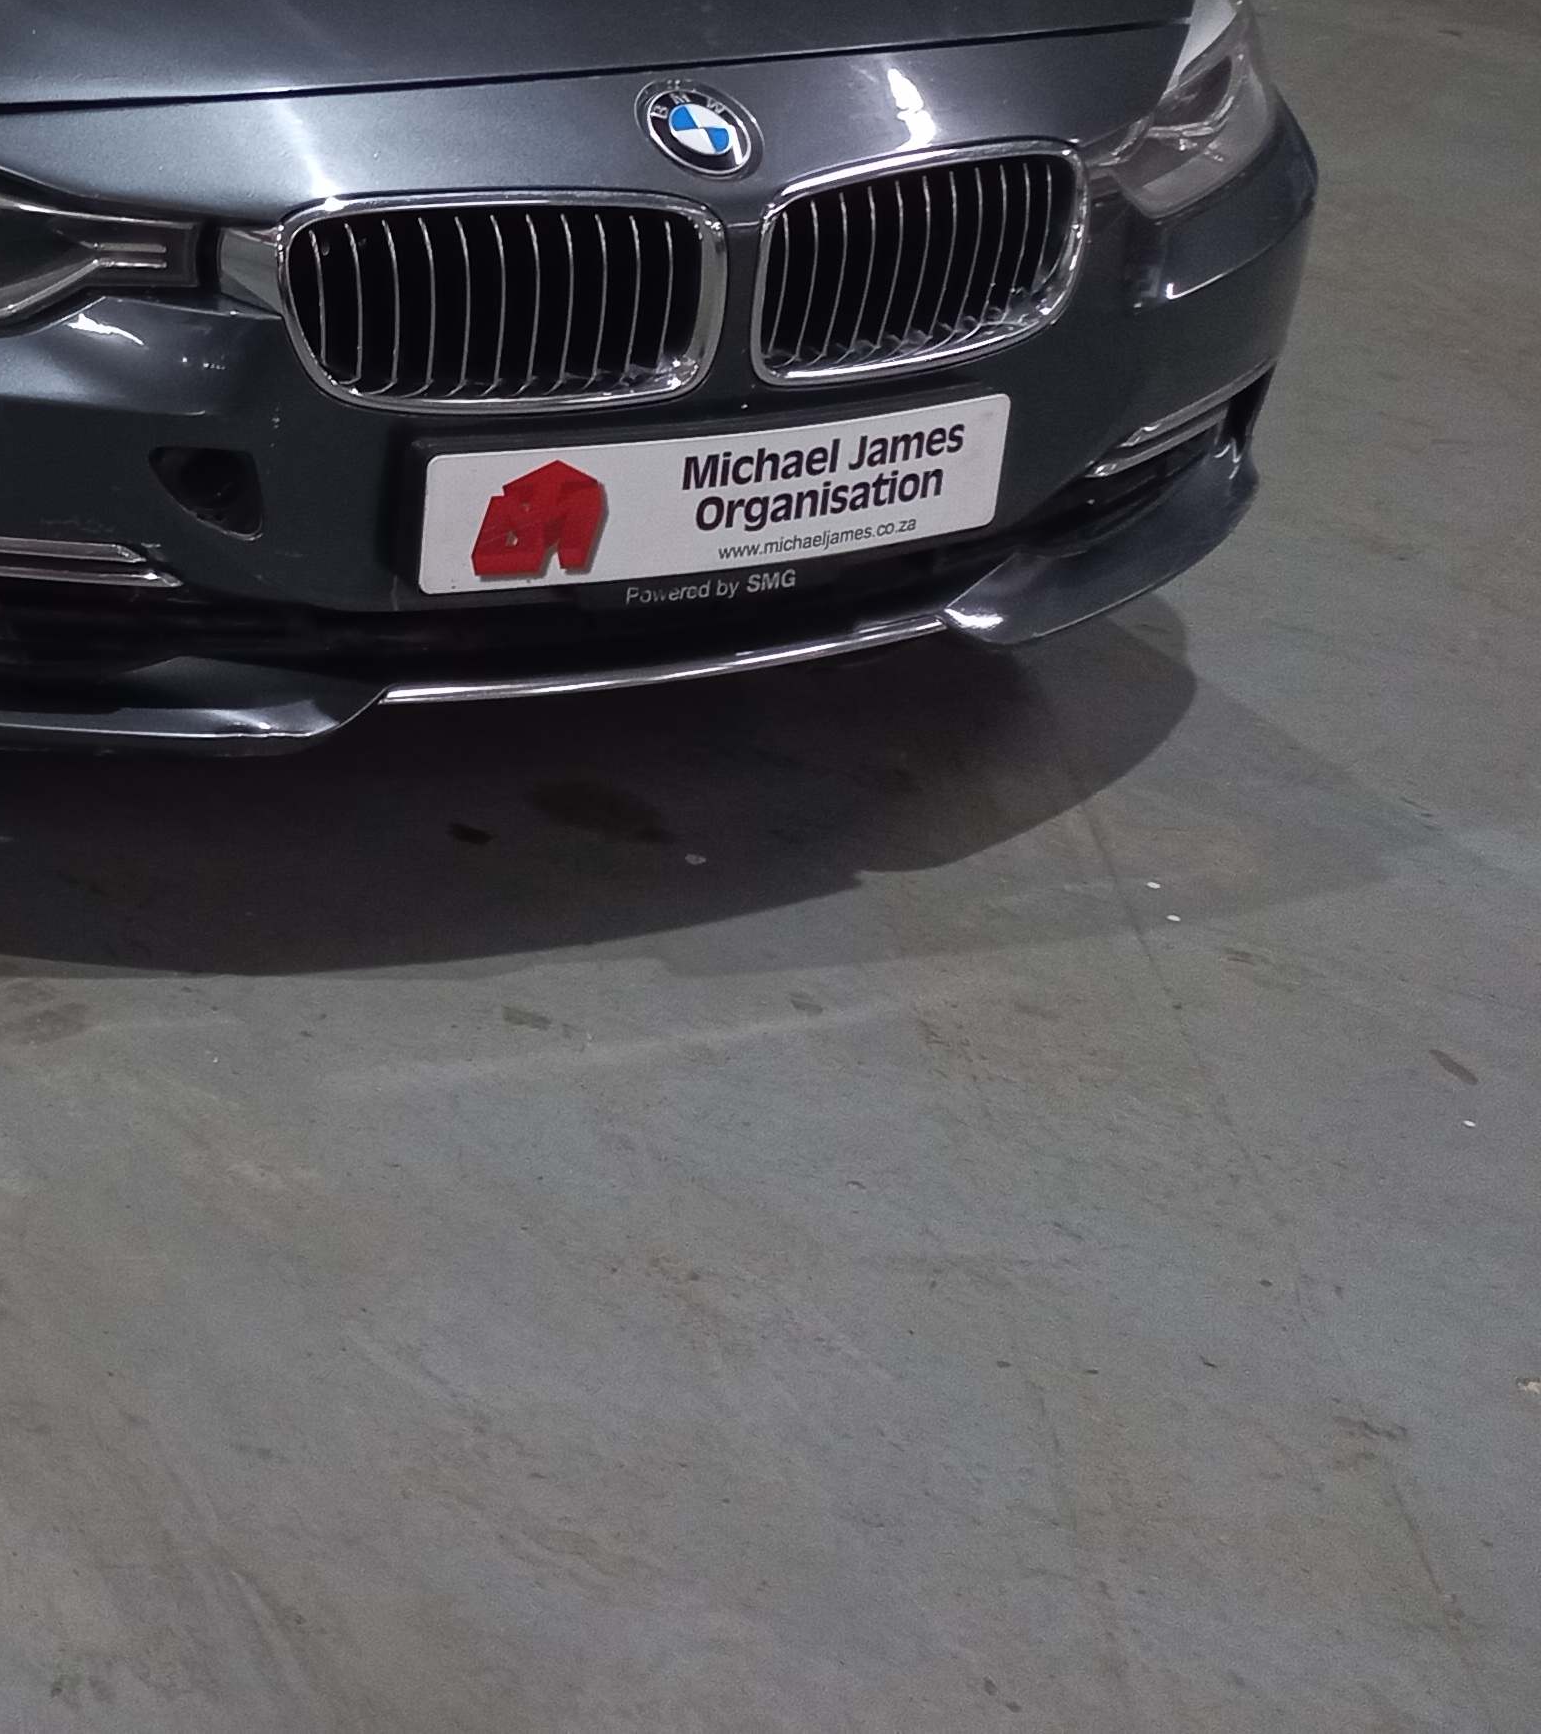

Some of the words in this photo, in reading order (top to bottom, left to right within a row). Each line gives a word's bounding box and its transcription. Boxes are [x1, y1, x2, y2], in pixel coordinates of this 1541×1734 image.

[650, 92, 726, 120] BMW
[682, 439, 841, 491] Michael
[848, 422, 966, 470] James
[696, 468, 944, 532] Organisation
[718, 517, 917, 560] www.michaeljames.co.za
[626, 580, 710, 605] Powered
[716, 578, 739, 599] by
[746, 569, 797, 594] SMG
